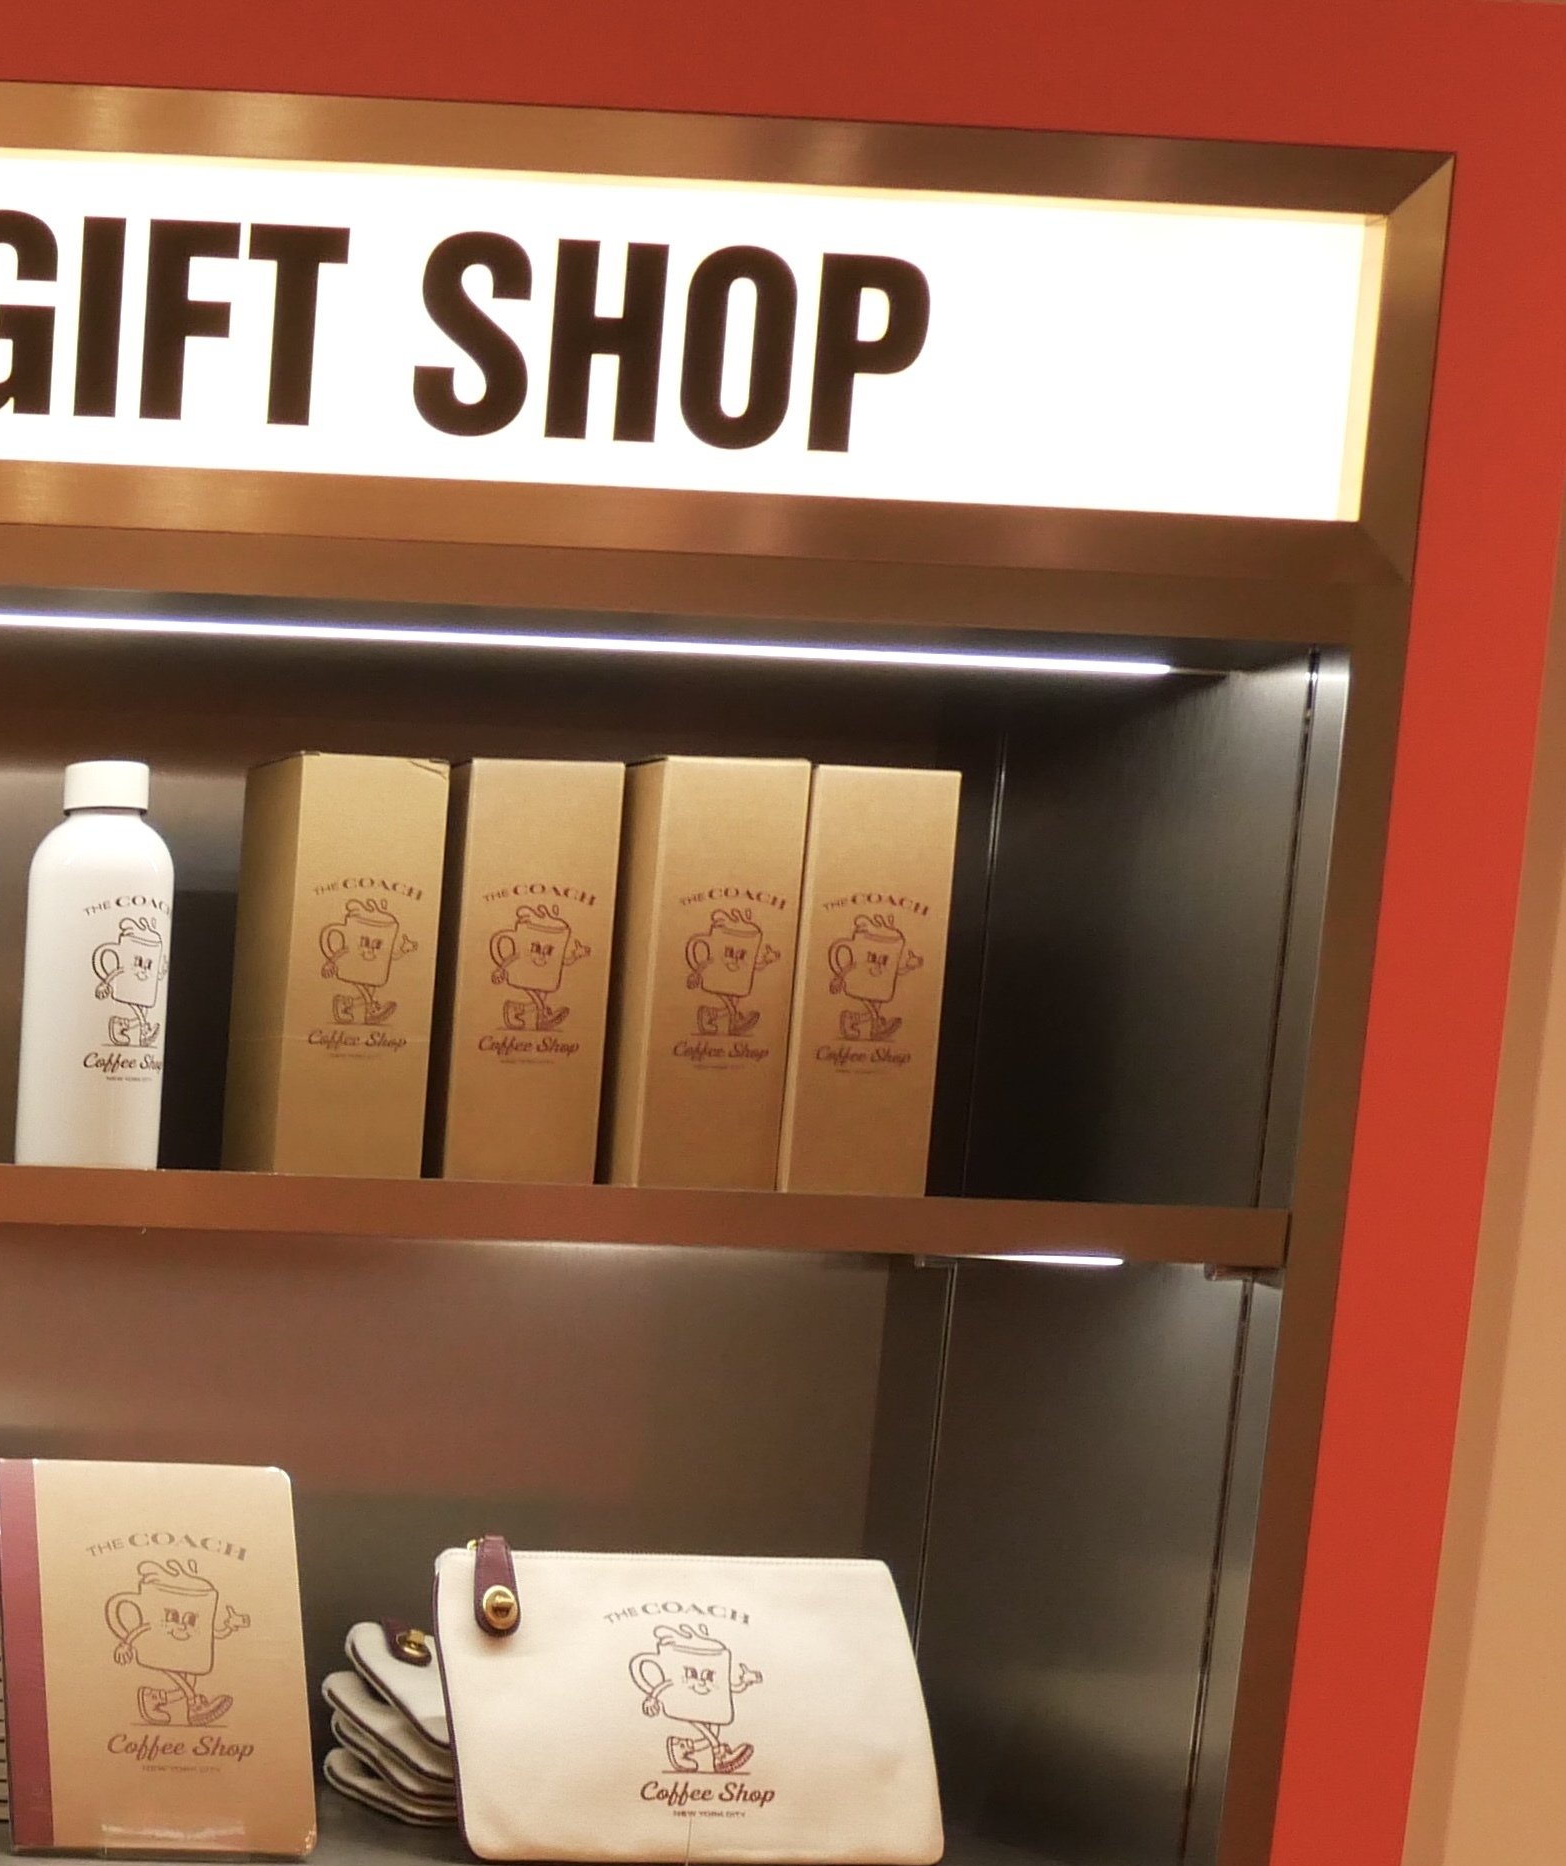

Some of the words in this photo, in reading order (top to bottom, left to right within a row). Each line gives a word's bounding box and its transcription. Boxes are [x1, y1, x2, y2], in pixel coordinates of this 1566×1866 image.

[412, 230, 931, 453] SHOP
[313, 881, 338, 896] THE
[342, 878, 423, 901] COACH
[483, 888, 508, 902] THE
[513, 883, 597, 906] COACH
[680, 891, 705, 906] THE
[709, 887, 787, 911] COACH
[83, 901, 110, 916] THE
[116, 896, 170, 915] COAC
[823, 899, 848, 911] THE
[852, 892, 929, 916] COACH
[308, 1030, 360, 1051] Coffee
[364, 1030, 407, 1052] Shop
[478, 1035, 532, 1055] Coffee
[536, 1035, 579, 1055] Shop
[673, 1041, 725, 1061] Coffee
[729, 1041, 769, 1061] Shop
[83, 1052, 136, 1072] Coffee
[816, 1045, 865, 1066] Coffee
[870, 1046, 911, 1066] Shop
[86, 1538, 124, 1557] THE
[128, 1532, 247, 1561] COACH
[603, 1607, 638, 1625] THE
[641, 1601, 750, 1625] COACH
[107, 1734, 187, 1761] Coffee
[192, 1735, 255, 1761] Shop
[640, 1781, 713, 1806] Coffee
[719, 1782, 776, 1807] Shop
